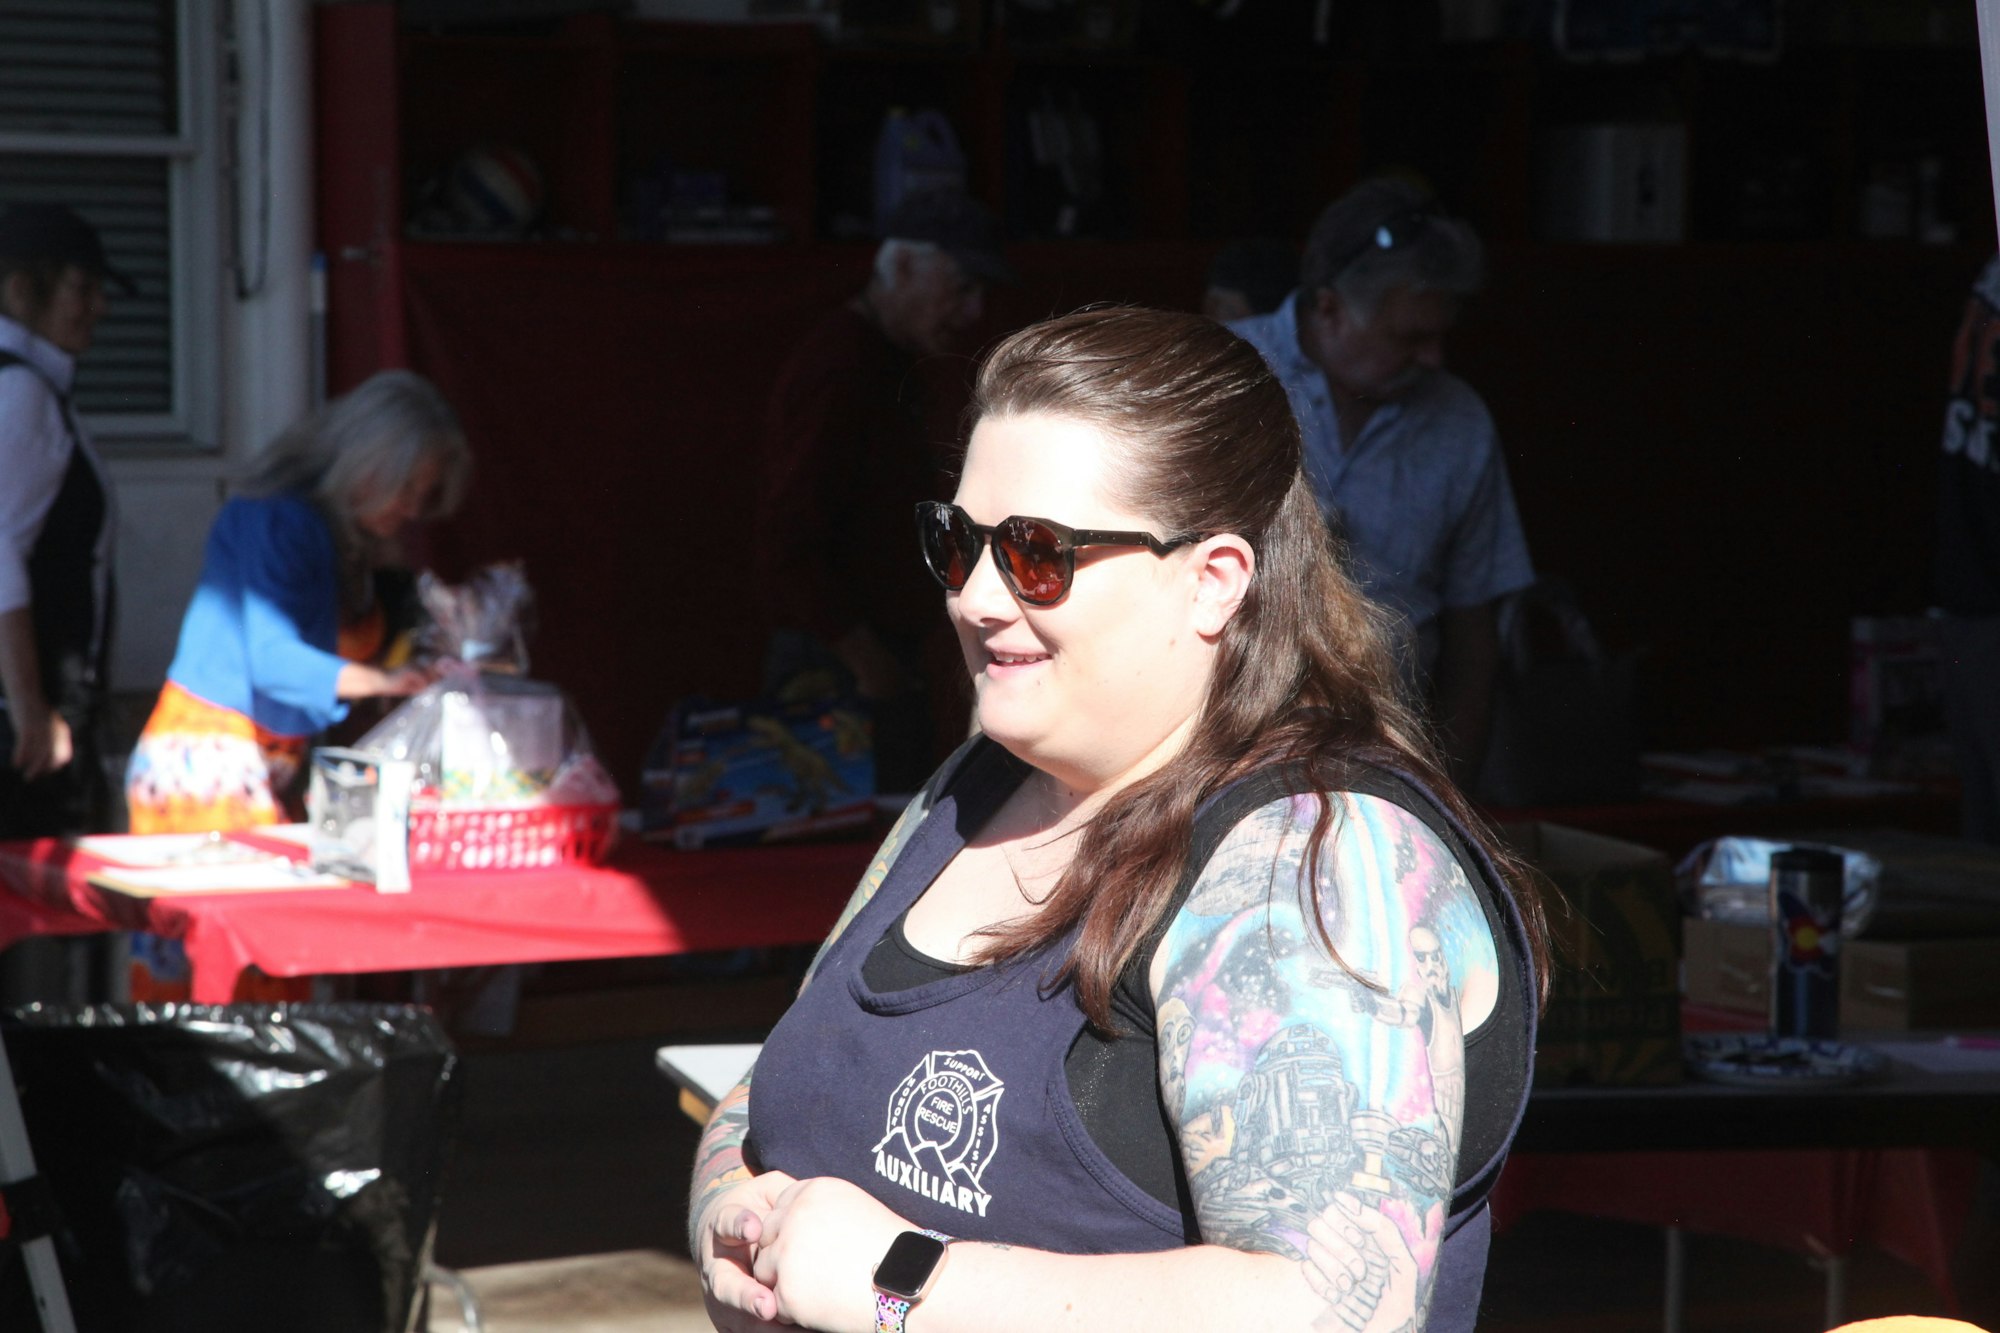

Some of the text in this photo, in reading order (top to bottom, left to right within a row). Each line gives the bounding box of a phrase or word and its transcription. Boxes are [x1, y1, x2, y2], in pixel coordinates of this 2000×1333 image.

[944, 1058, 985, 1081] SUPPORT
[892, 1078, 915, 1126] HONOR
[920, 1075, 973, 1115] FOOTHILLS
[931, 1096, 954, 1115] FIRE
[917, 1107, 957, 1133] RESCUE
[970, 1104, 991, 1172] ASSIST
[875, 1150, 992, 1217] AUXILIARY
